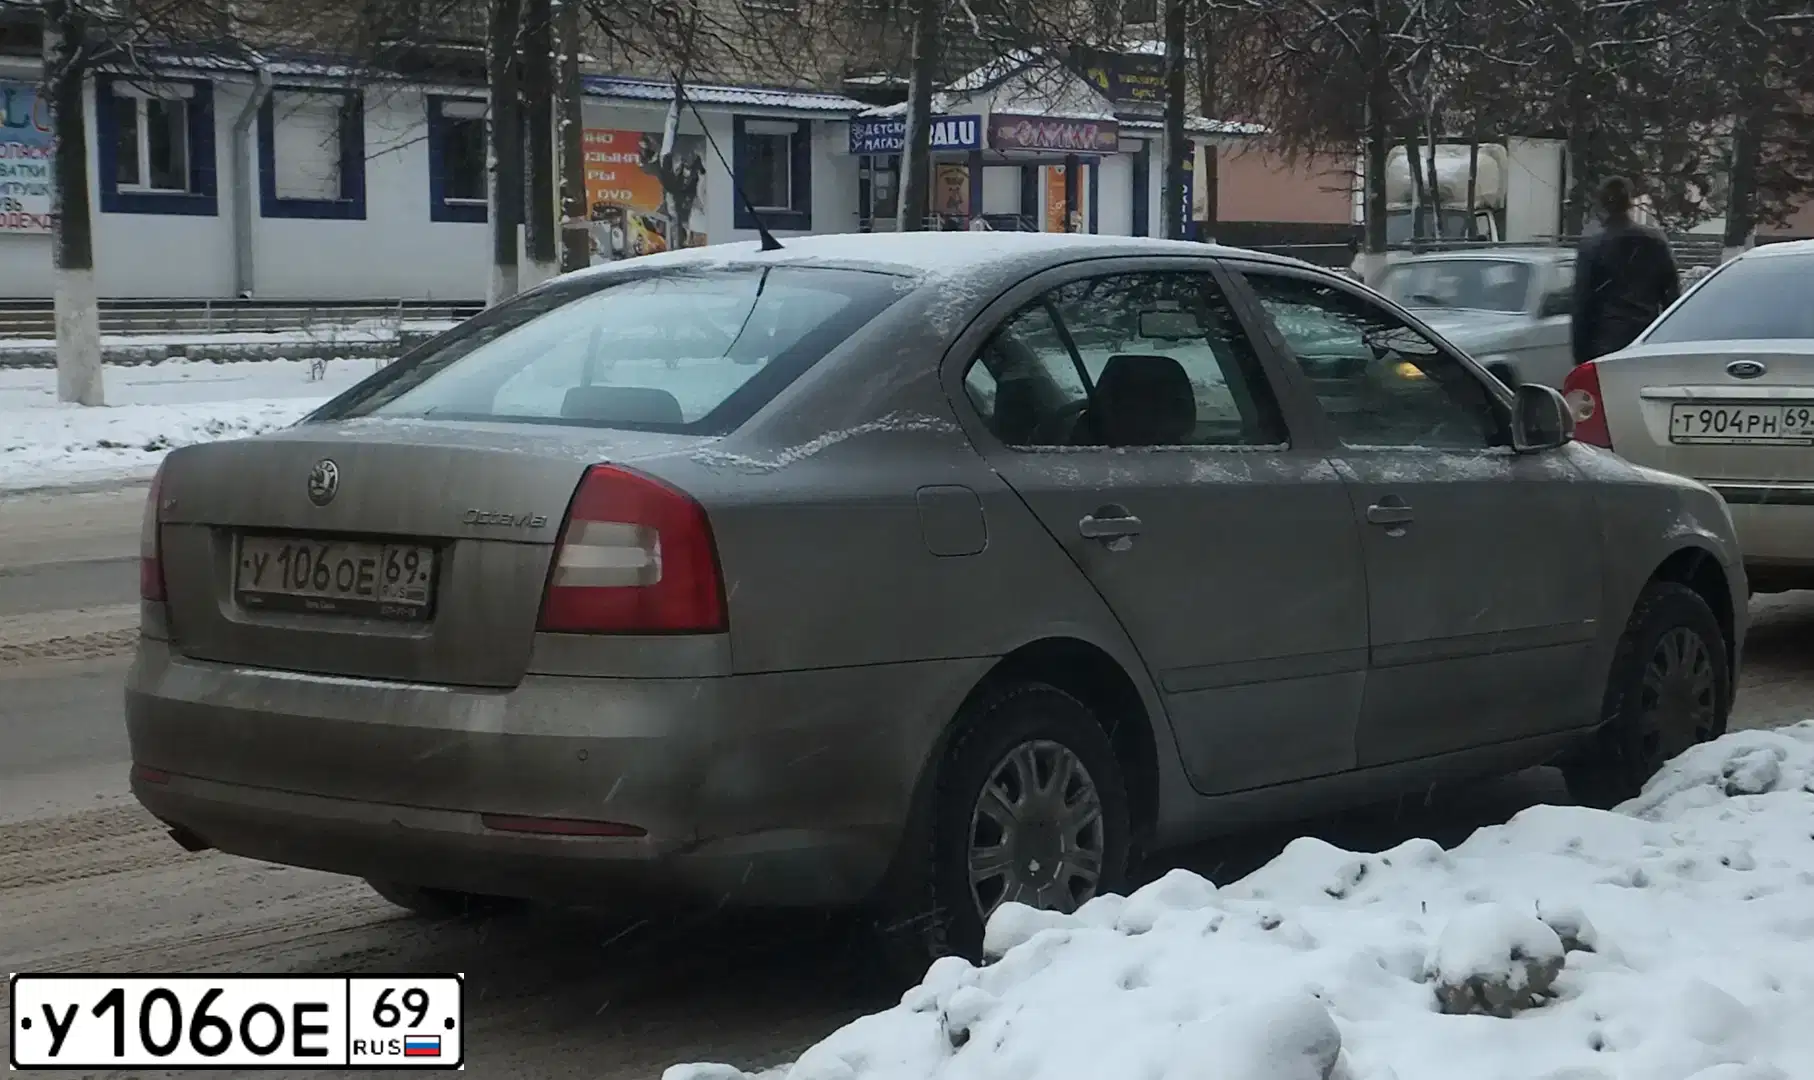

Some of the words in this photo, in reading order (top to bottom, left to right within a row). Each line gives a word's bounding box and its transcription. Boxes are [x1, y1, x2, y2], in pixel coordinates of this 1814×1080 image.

[597, 188, 632, 201] DVD
[1683, 409, 1777, 434] Т904РН
[1785, 409, 1810, 428] 69
[463, 508, 548, 529] Octavia
[252, 544, 375, 595] У106ОЕ
[386, 549, 419, 584] 69
